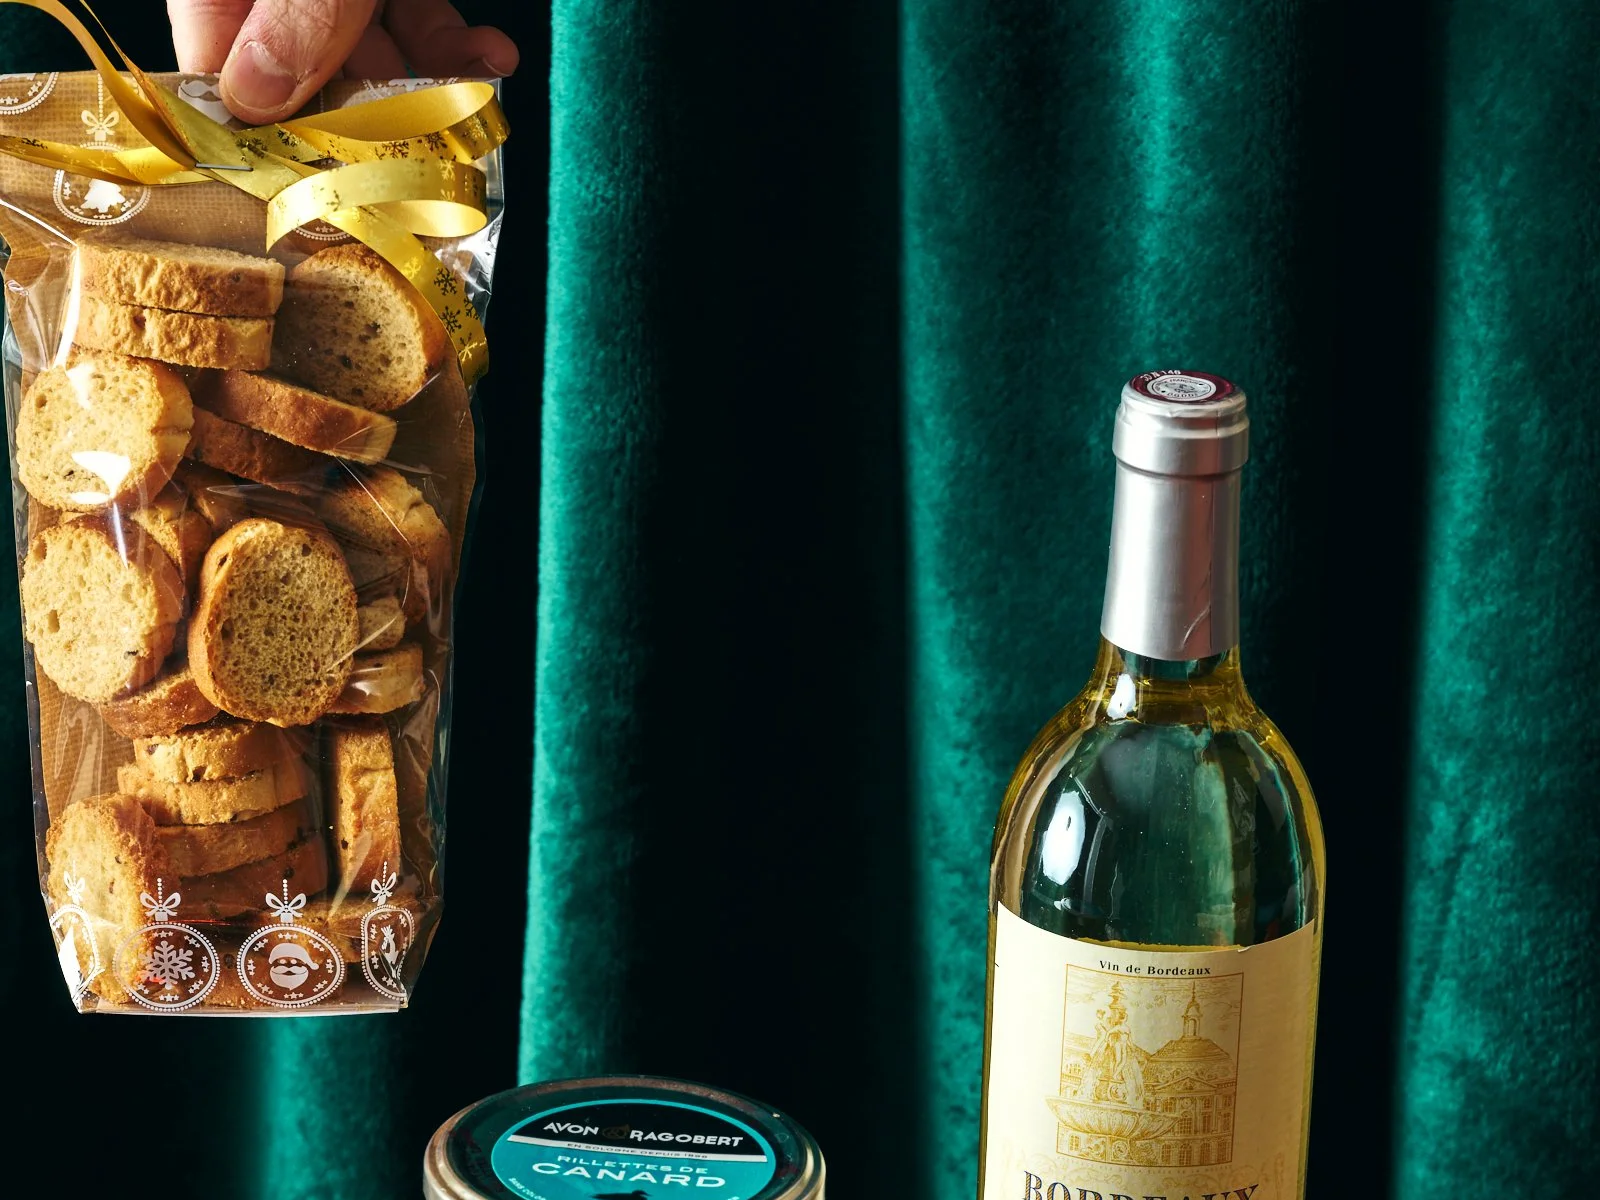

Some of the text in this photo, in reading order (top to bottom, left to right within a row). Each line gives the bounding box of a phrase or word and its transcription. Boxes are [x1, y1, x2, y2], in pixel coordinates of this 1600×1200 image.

[1099, 960, 1212, 976] Vin de Bordeaux
[543, 1122, 600, 1136] AVON
[630, 1130, 744, 1148] RAGOBERT
[585, 1145, 638, 1154] SOLOGNE
[558, 1156, 708, 1174] RILLETTES DE
[532, 1163, 726, 1188] CANARD
